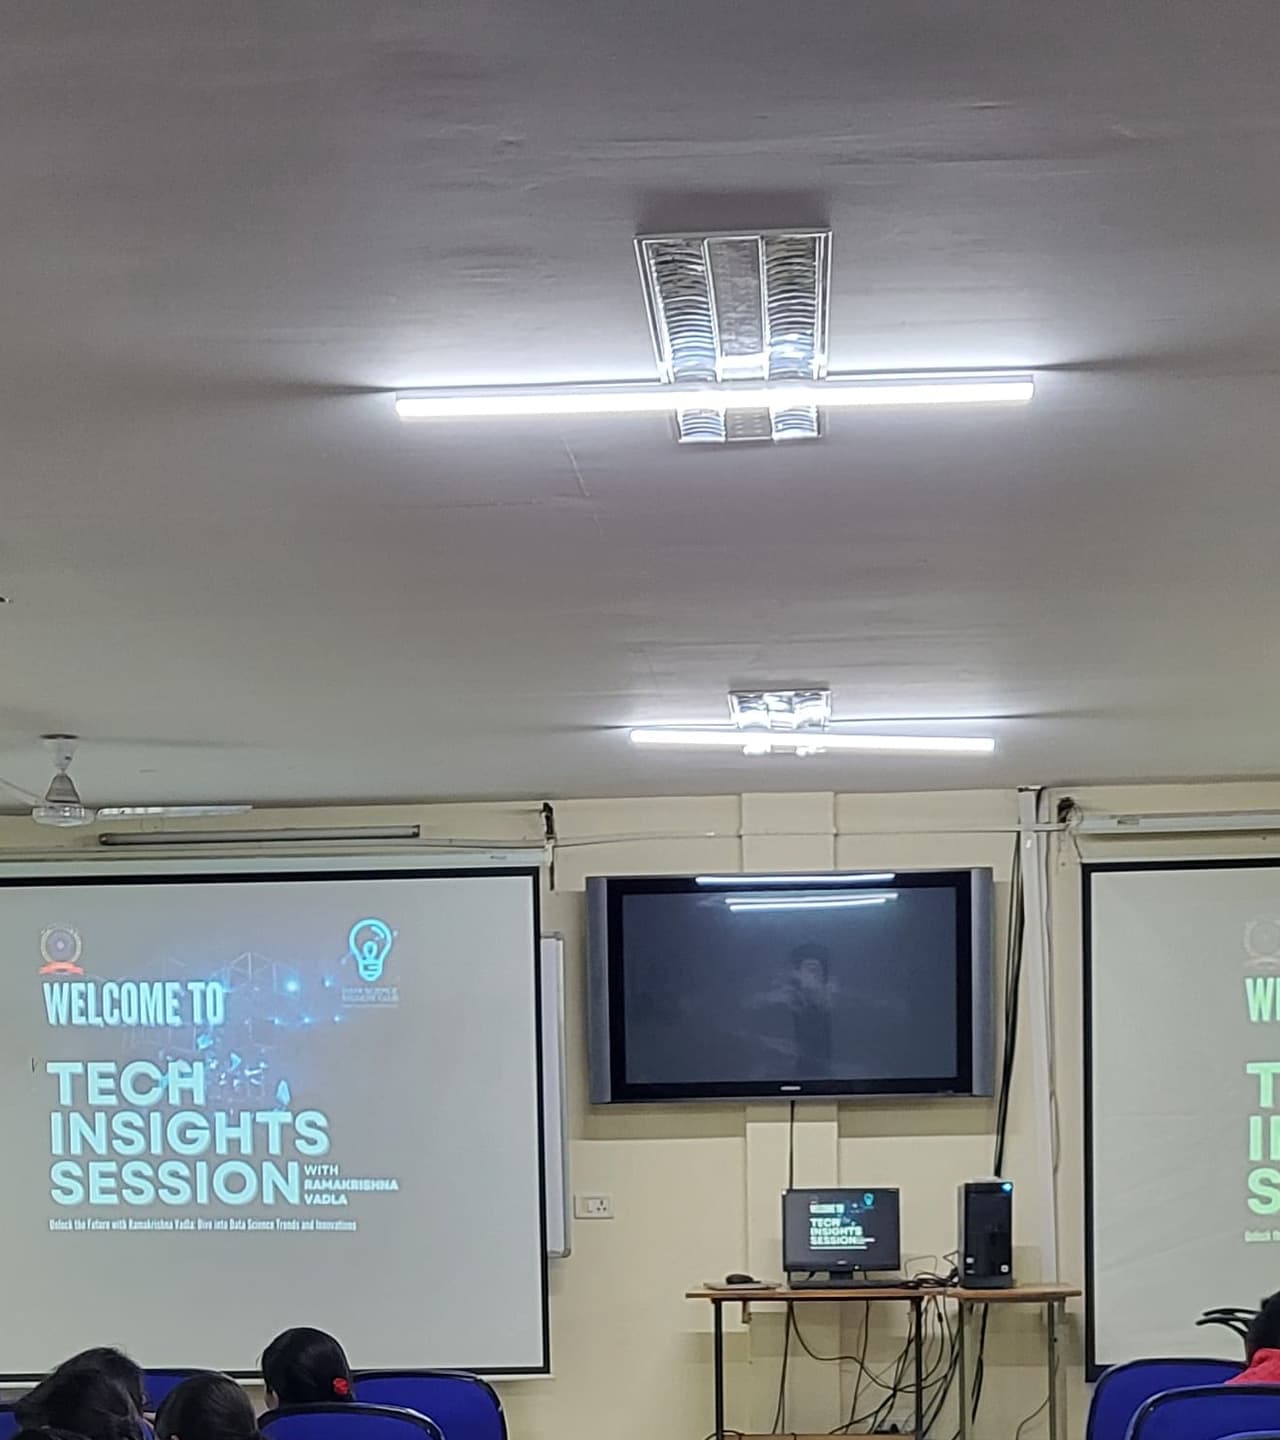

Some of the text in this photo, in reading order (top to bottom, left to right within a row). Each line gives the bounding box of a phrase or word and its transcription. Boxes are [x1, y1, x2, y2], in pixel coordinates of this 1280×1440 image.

[43, 981, 225, 1027] WELCOME TO
[47, 1060, 207, 1106] TECH
[50, 1111, 330, 1156] INSIGHTS
[304, 1164, 339, 1176] WITH
[50, 1161, 300, 1205] SESSION
[304, 1193, 348, 1205] VADLA
[809, 1217, 840, 1228] TECH
[809, 1226, 863, 1236] INSIGHTS
[809, 1235, 857, 1246] SESSION
